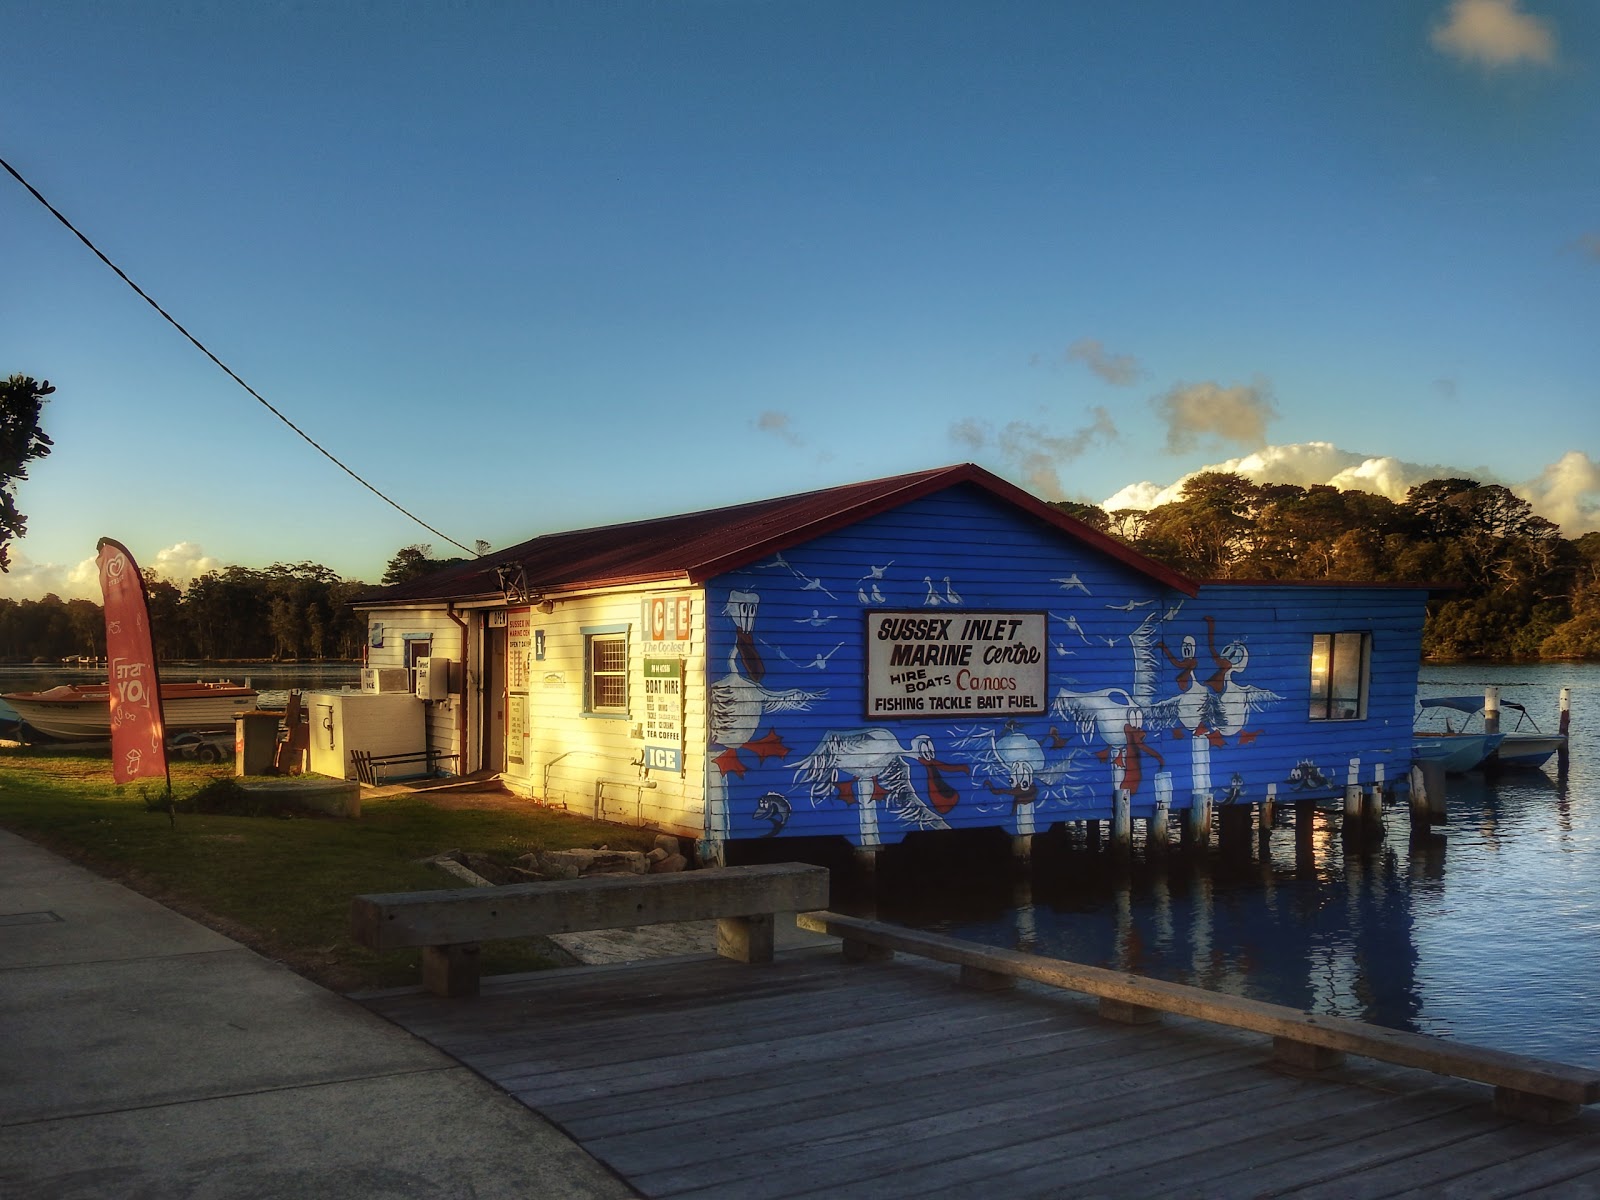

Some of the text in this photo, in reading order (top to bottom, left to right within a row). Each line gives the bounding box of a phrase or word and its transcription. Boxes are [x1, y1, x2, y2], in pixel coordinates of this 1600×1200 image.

[644, 600, 688, 632] ICEE
[877, 618, 1023, 641] SUSSEX INLET
[642, 641, 686, 653] The Coolest
[889, 642, 1041, 666] MARINE centre
[890, 669, 927, 685] HIRE
[905, 675, 951, 693] BOATS
[645, 679, 679, 695] BOAT HIRE
[875, 695, 1038, 711] FISHING TACKLE BAIT FUEL
[647, 730, 680, 741] TEA COFFEE
[649, 749, 676, 769] ICE
